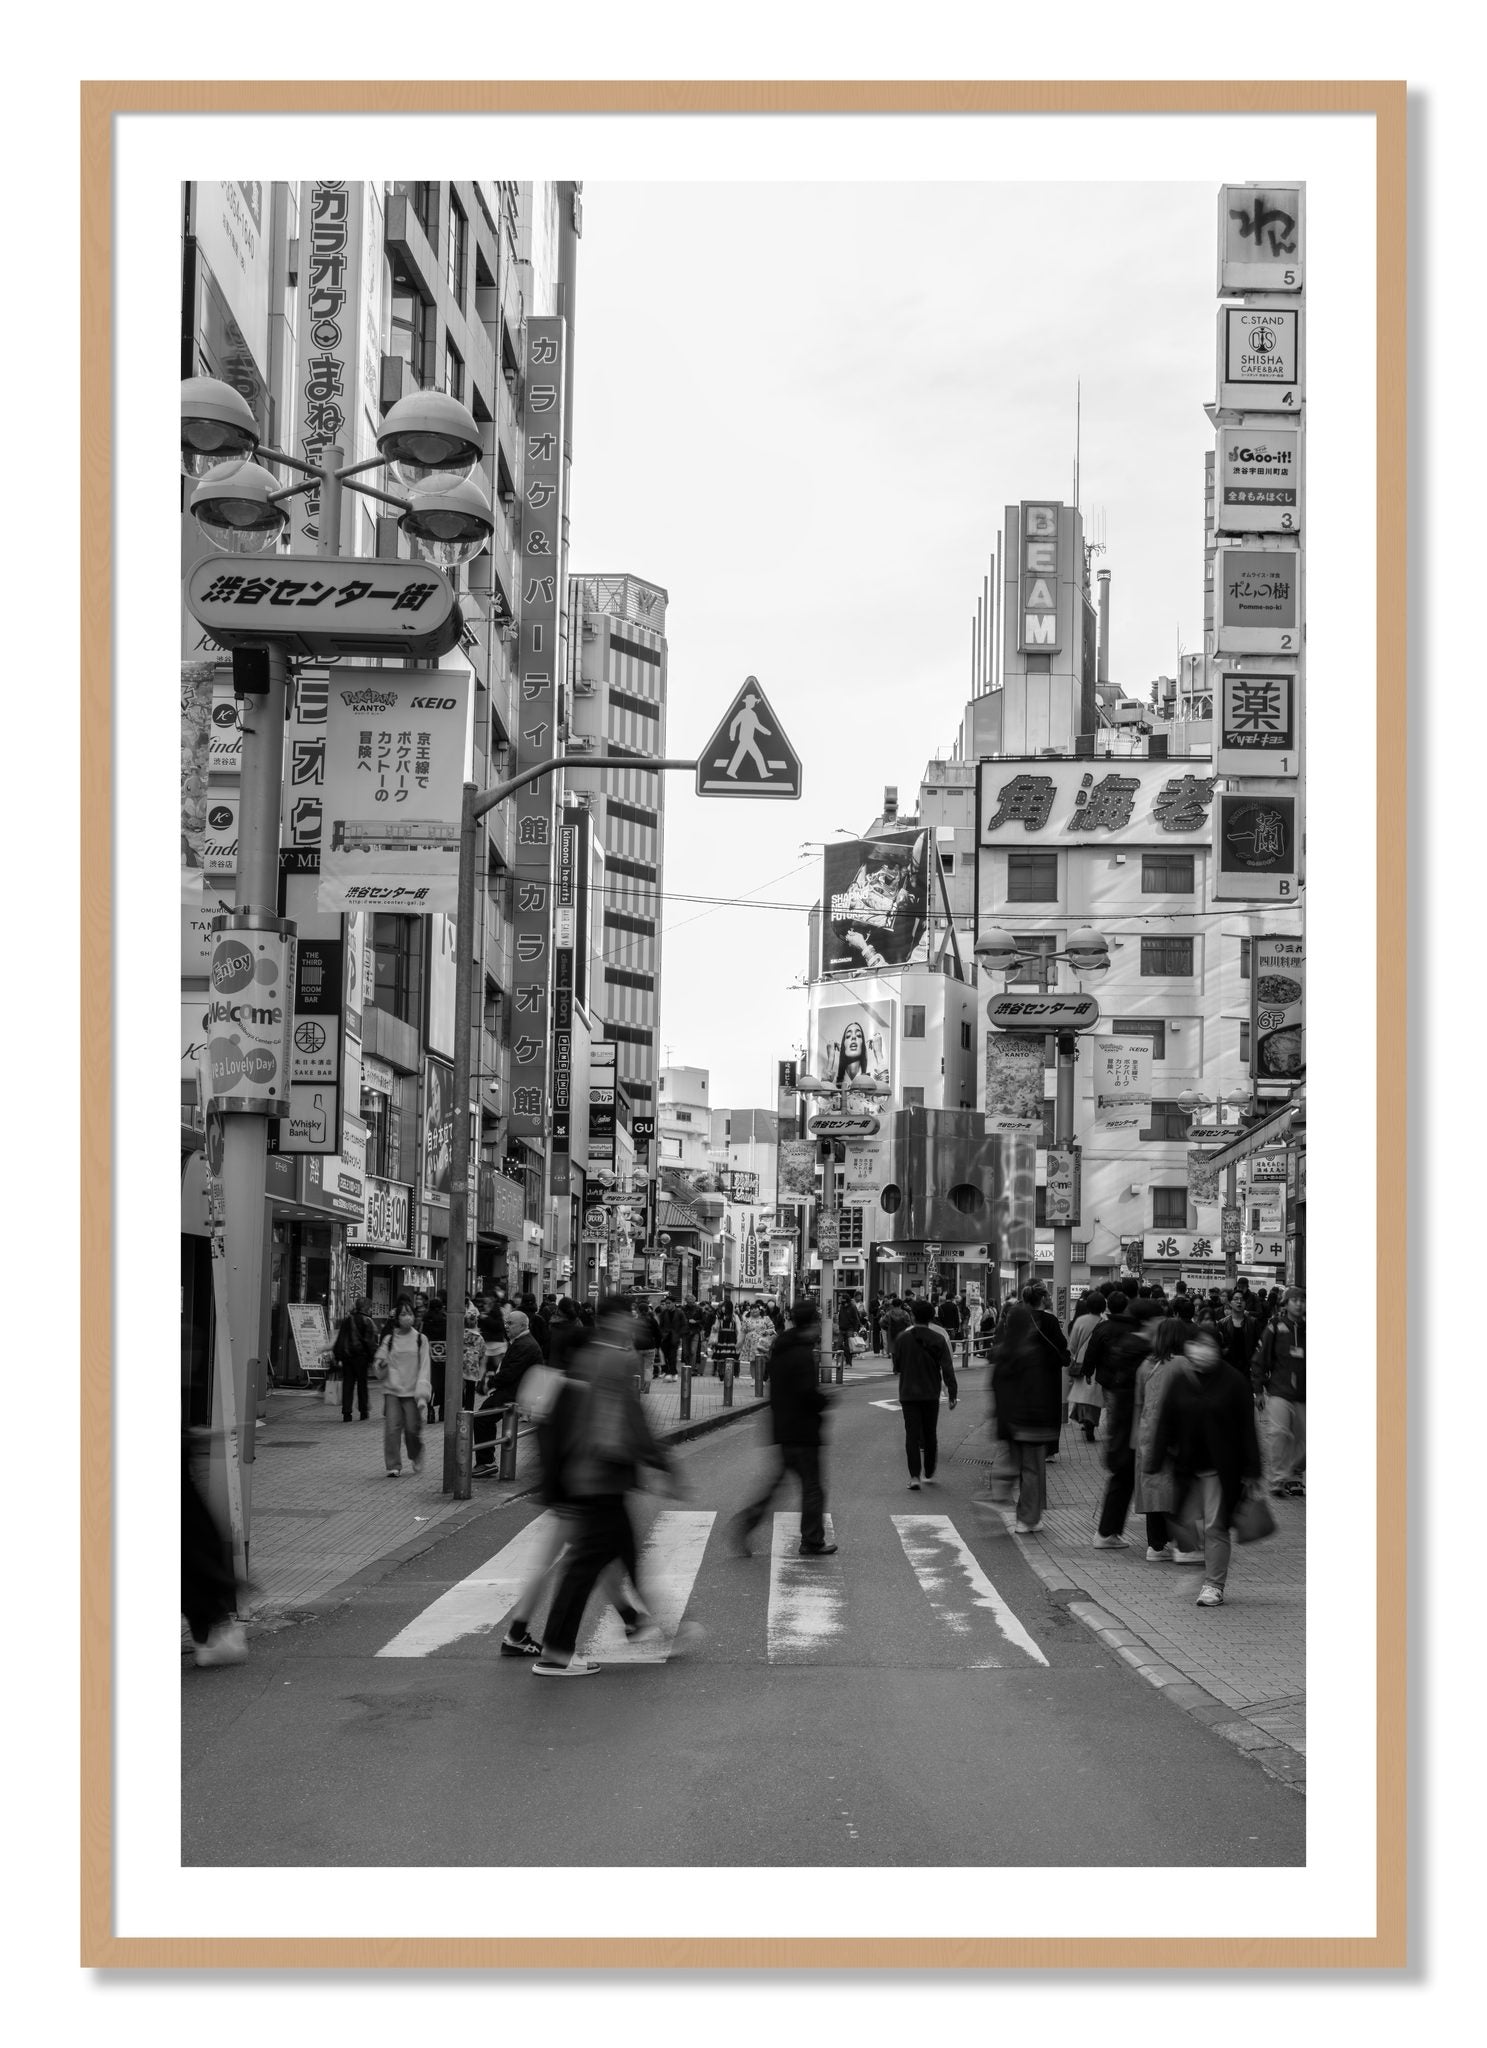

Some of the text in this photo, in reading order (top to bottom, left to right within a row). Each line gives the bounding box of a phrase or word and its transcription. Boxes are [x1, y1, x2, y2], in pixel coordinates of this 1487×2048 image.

[310, 190, 349, 321] カラオケ
[1284, 271, 1295, 285] 5
[1241, 316, 1284, 325] C.STAND
[1241, 355, 1284, 365] SHISHA
[1241, 365, 1284, 374] CAFE&BAR
[1239, 448, 1292, 463] Goo-it!
[1233, 467, 1288, 476] 渋谷宇田川町店
[1228, 491, 1293, 502] 全身もみほぐし
[1281, 512, 1292, 528] 3
[1027, 507, 1056, 644] BEAM
[201, 575, 439, 611] 渋谷センター街
[1239, 603, 1282, 611] Pomme-no-ki
[1281, 635, 1292, 649] 2
[410, 697, 457, 710] KEIO
[1232, 681, 1281, 729] 薬
[1226, 732, 1286, 746] マツモトキヨシ
[357, 731, 373, 772] 冒険へ
[375, 731, 392, 802] カントーの
[415, 732, 431, 789] 京王線で
[1280, 757, 1288, 772] 1
[988, 774, 1215, 832] 角海老
[1227, 811, 1285, 857] 一蘭
[209, 860, 233, 868] 渋谷店
[562, 830, 571, 901] kimono hearts
[345, 886, 430, 899] 渋谷センター街
[1280, 880, 1290, 895] B
[213, 953, 250, 986] Enjoy
[512, 884, 547, 1117] カラオケ館
[210, 1001, 282, 1025] Welcome
[994, 1002, 1092, 1015] 渋谷センター街
[1258, 1011, 1285, 1030] 6F
[225, 1057, 254, 1074] Lovely
[256, 1057, 275, 1071] Day!
[289, 1120, 321, 1130] Whisky
[634, 1123, 653, 1133] GU
[811, 1120, 871, 1128] 渋谷センター街
[289, 1129, 309, 1137] Bank
[1157, 1237, 1213, 1257] 兆楽
[747, 1236, 756, 1275] BEER
